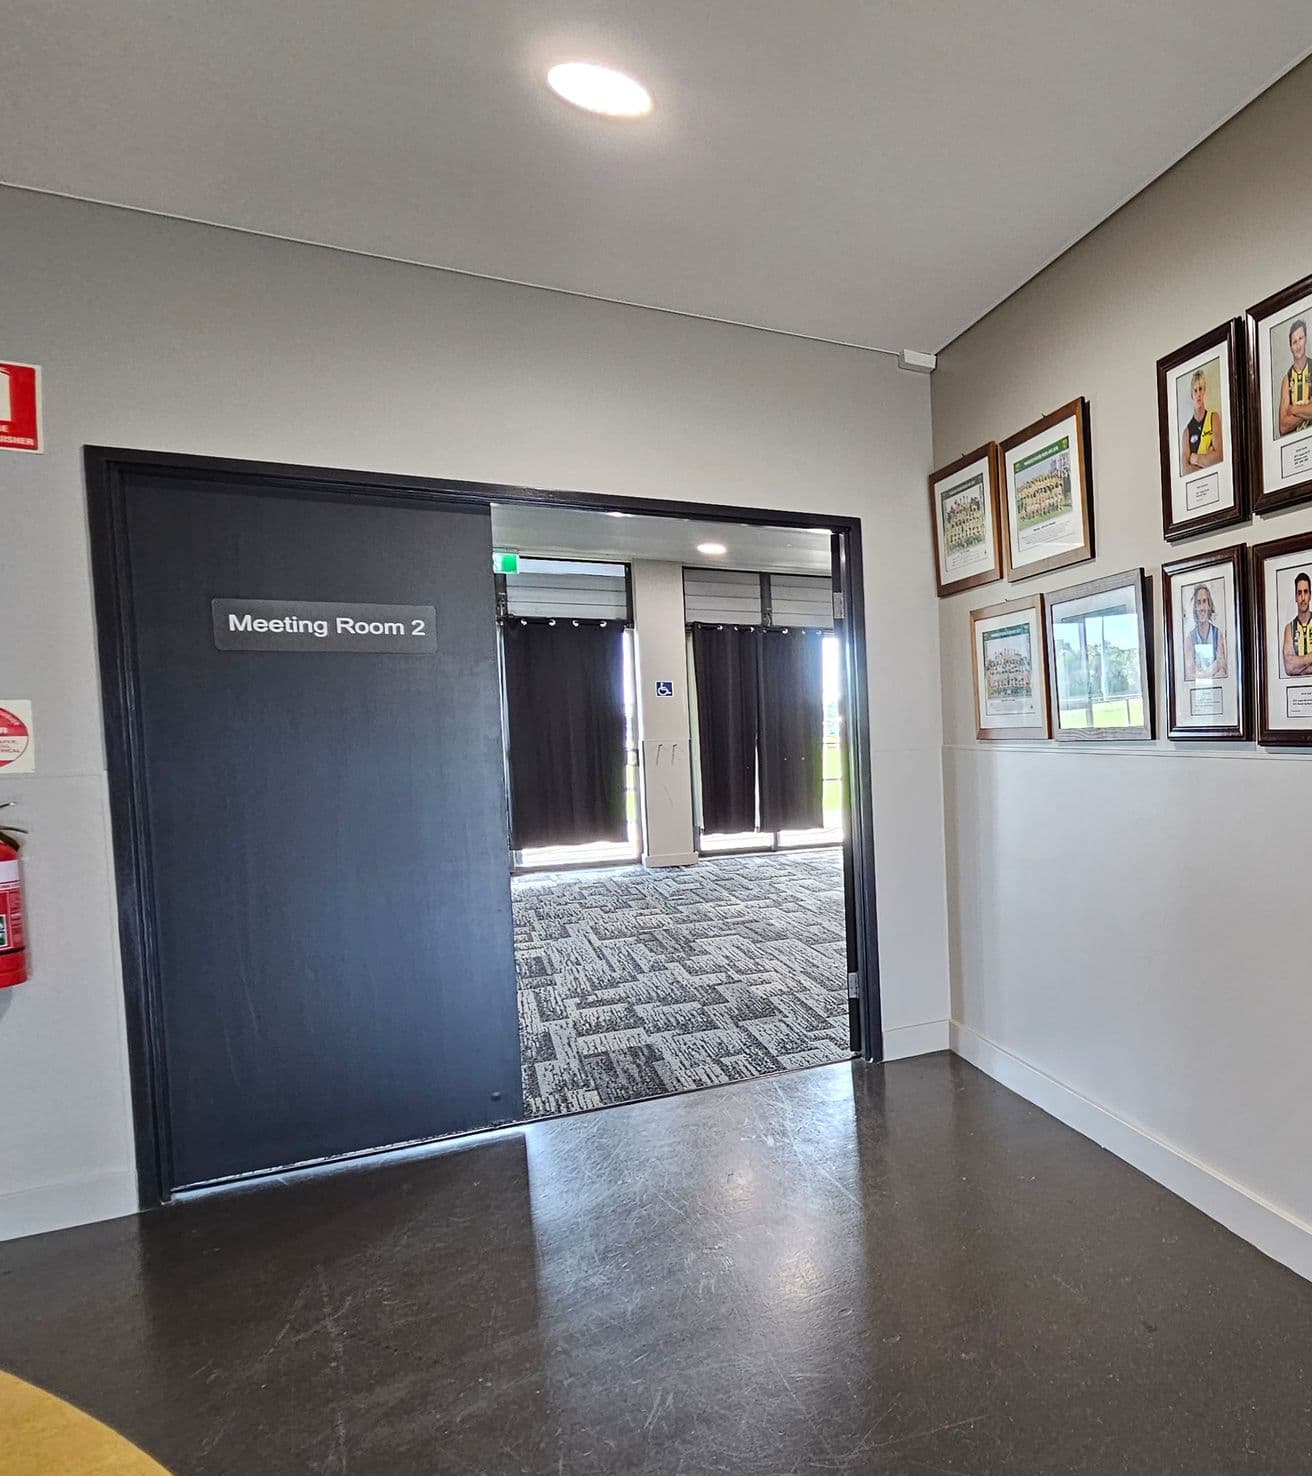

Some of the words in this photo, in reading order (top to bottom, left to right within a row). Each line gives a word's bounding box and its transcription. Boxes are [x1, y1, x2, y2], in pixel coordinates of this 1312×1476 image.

[228, 614, 329, 638] Meeting
[335, 617, 405, 635] Room
[411, 619, 426, 636] 2
